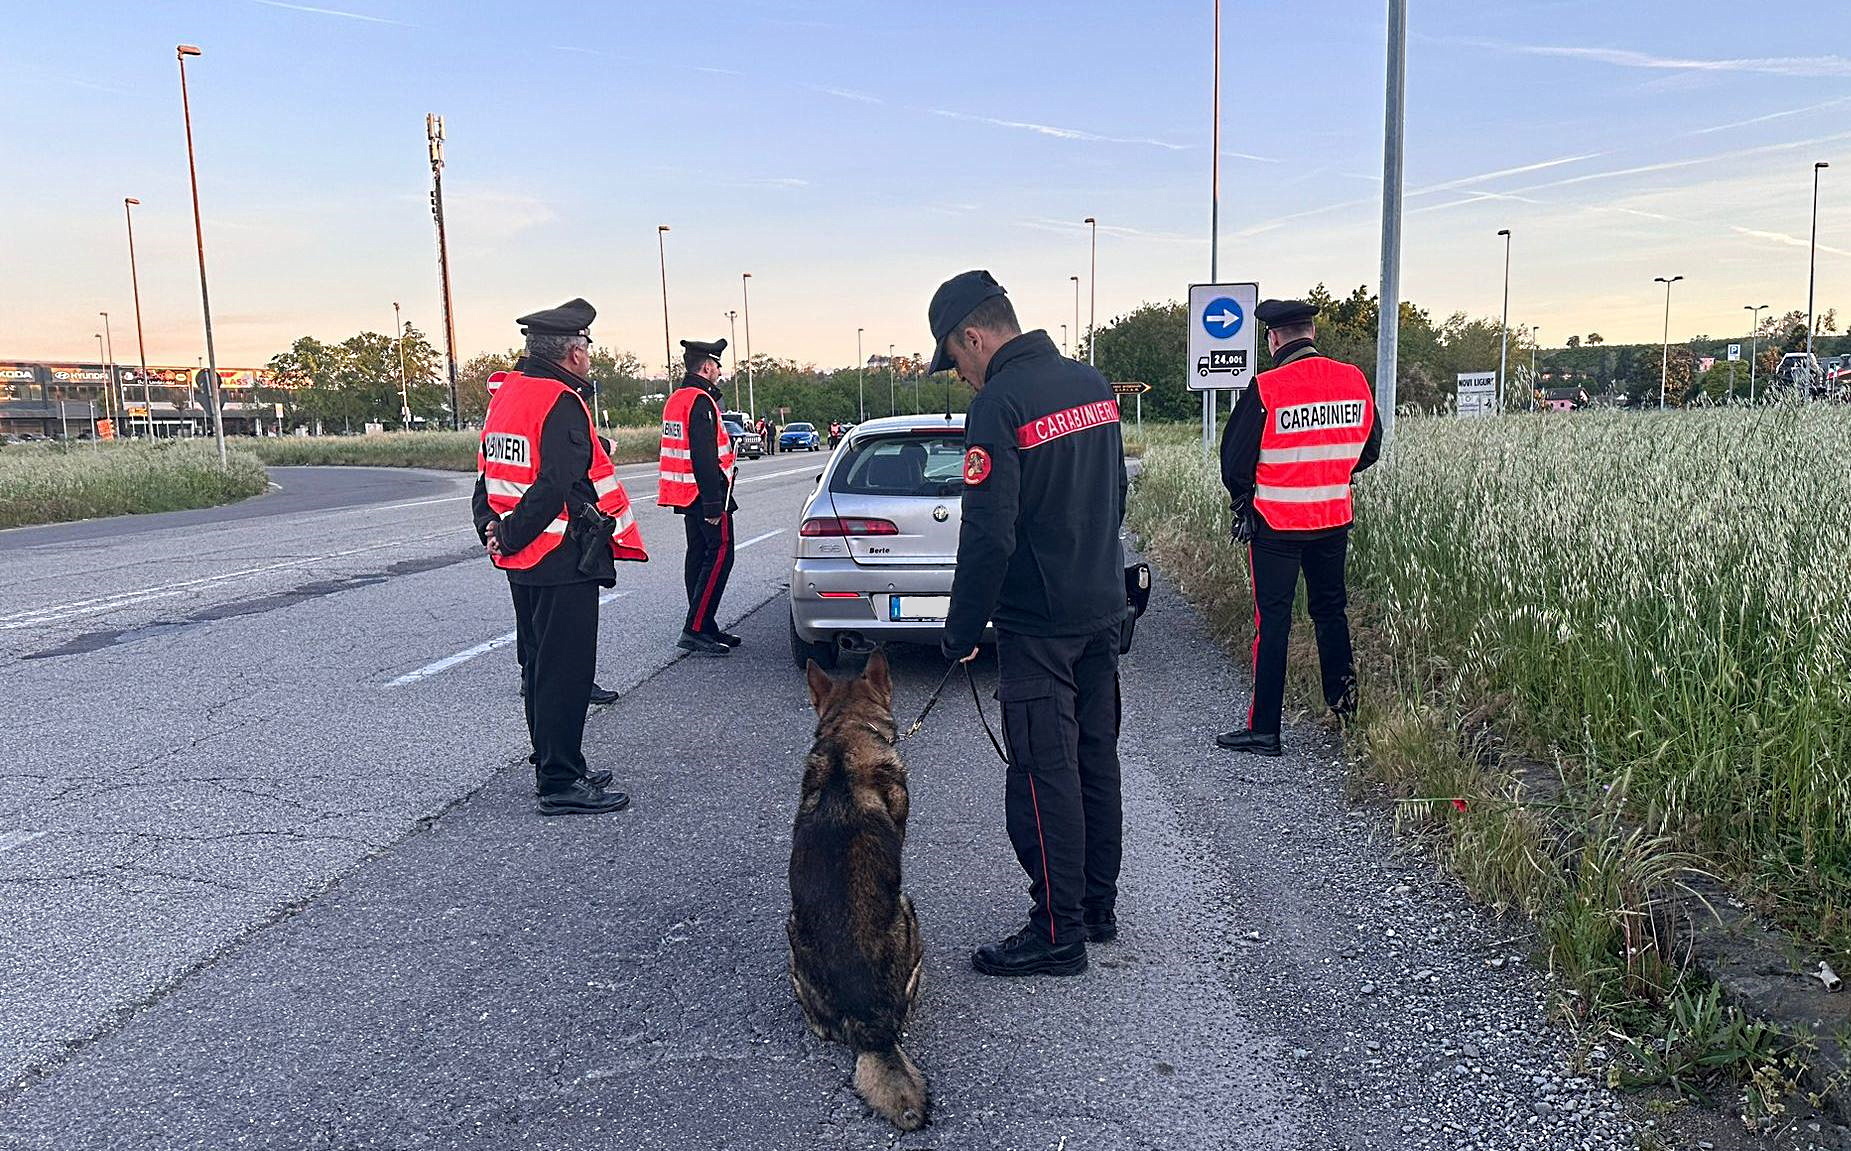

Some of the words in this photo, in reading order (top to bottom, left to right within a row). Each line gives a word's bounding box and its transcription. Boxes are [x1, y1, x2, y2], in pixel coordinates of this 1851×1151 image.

[1458, 379, 1473, 387] NOVI
[1035, 401, 1115, 440] CARABINIERI
[1280, 403, 1362, 430] CARABINIERI
[482, 437, 525, 463] BINIERI
